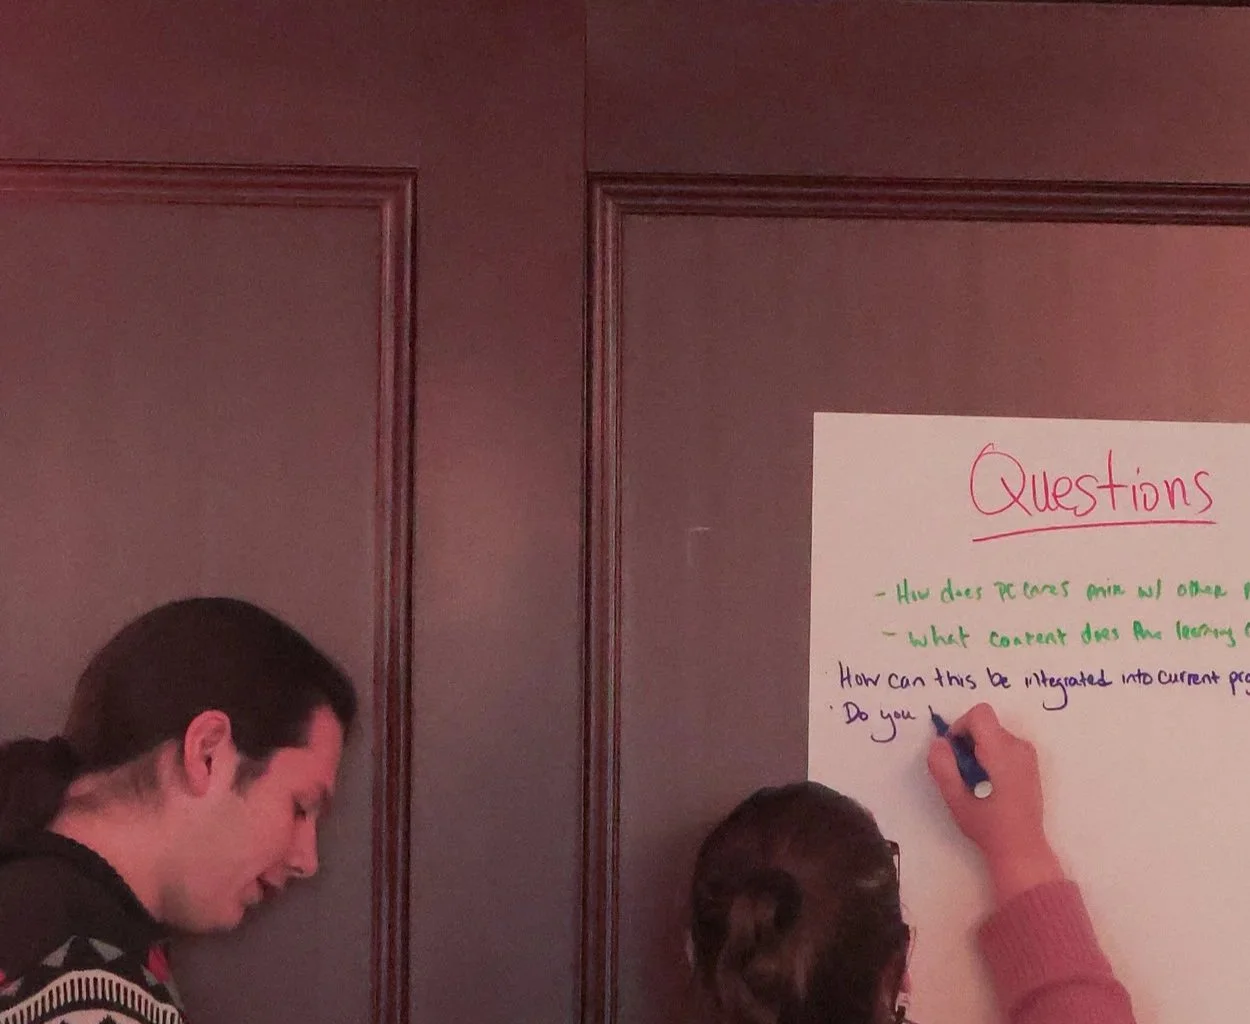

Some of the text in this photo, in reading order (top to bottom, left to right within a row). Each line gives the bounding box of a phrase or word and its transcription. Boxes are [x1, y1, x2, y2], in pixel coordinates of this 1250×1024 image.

[970, 442, 1213, 517] Questions
[896, 578, 930, 604] How
[940, 578, 982, 604] does
[1137, 578, 1162, 600] w/
[1081, 622, 1119, 643] does
[838, 661, 880, 688] How
[888, 672, 925, 689] can
[934, 667, 977, 690] this
[986, 667, 1011, 689] be
[1024, 669, 1112, 711] integrated
[1121, 668, 1153, 685] into
[842, 701, 916, 743] Do you
